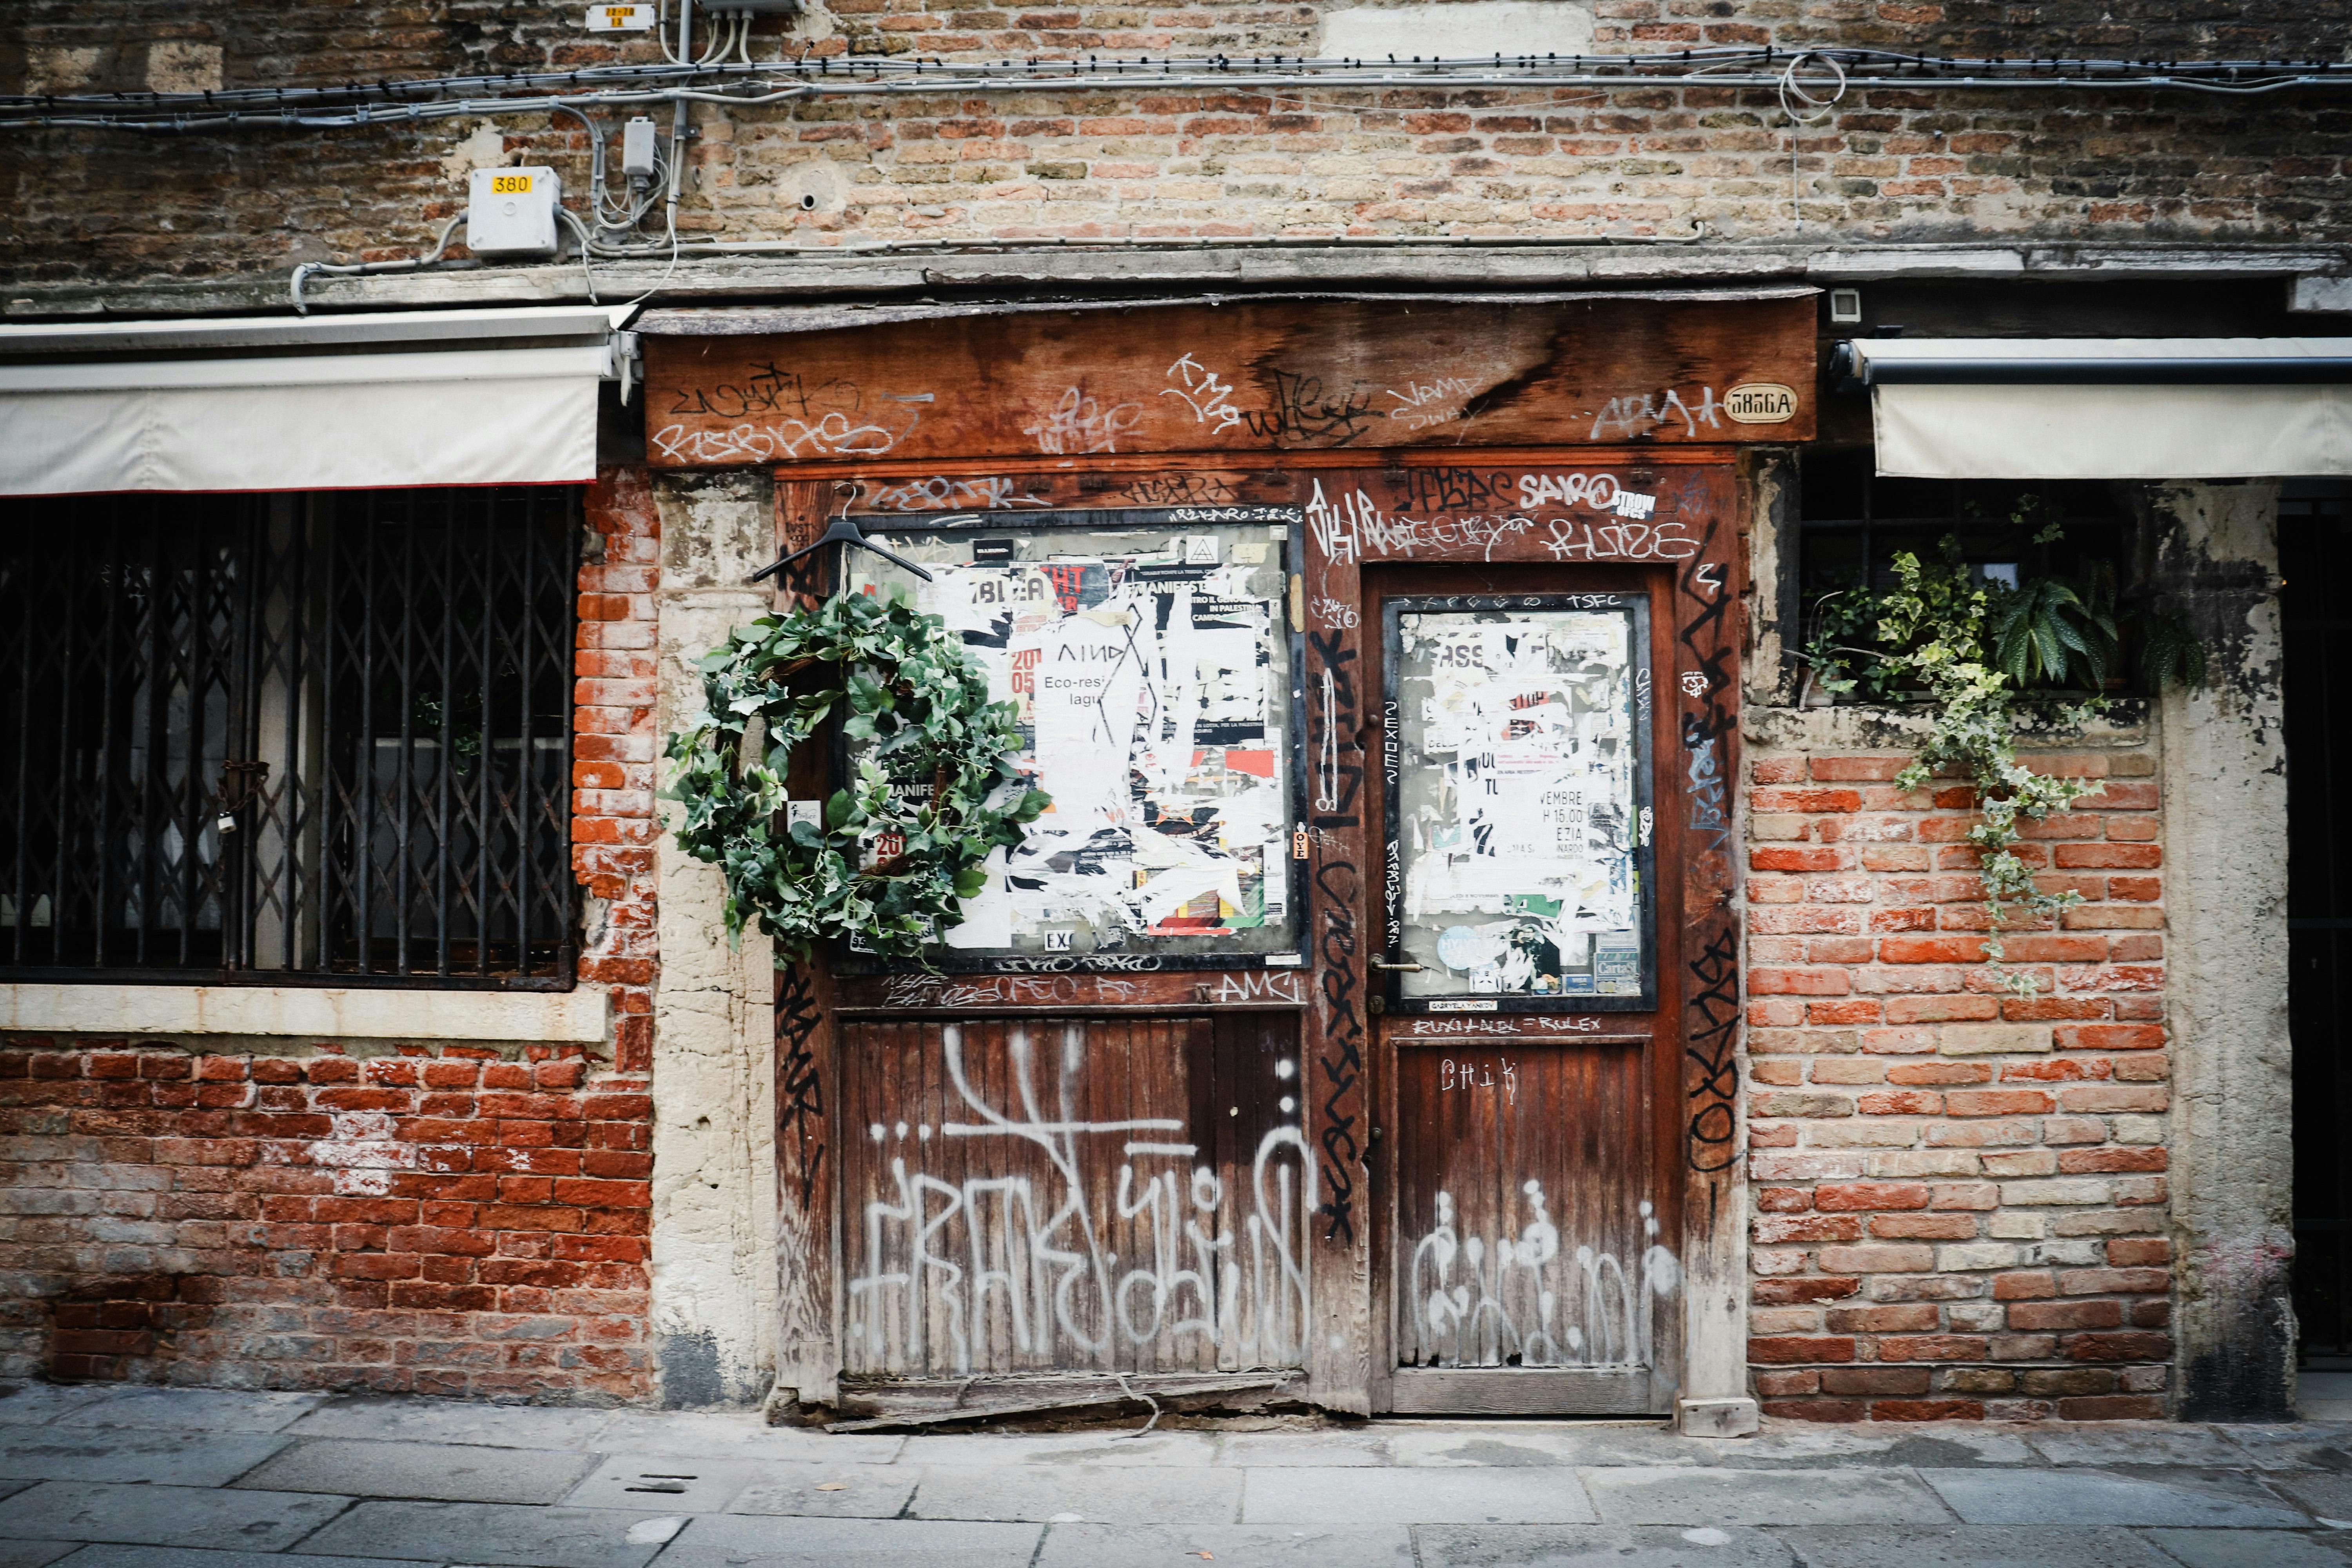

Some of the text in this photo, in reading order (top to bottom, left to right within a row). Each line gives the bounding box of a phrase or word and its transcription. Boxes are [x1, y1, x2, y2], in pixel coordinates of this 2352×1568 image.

[495, 176, 528, 192] 380
[1387, 377, 1483, 406] VAMP
[1012, 672, 1034, 693] 05
[1554, 809, 1583, 823] 15.00
